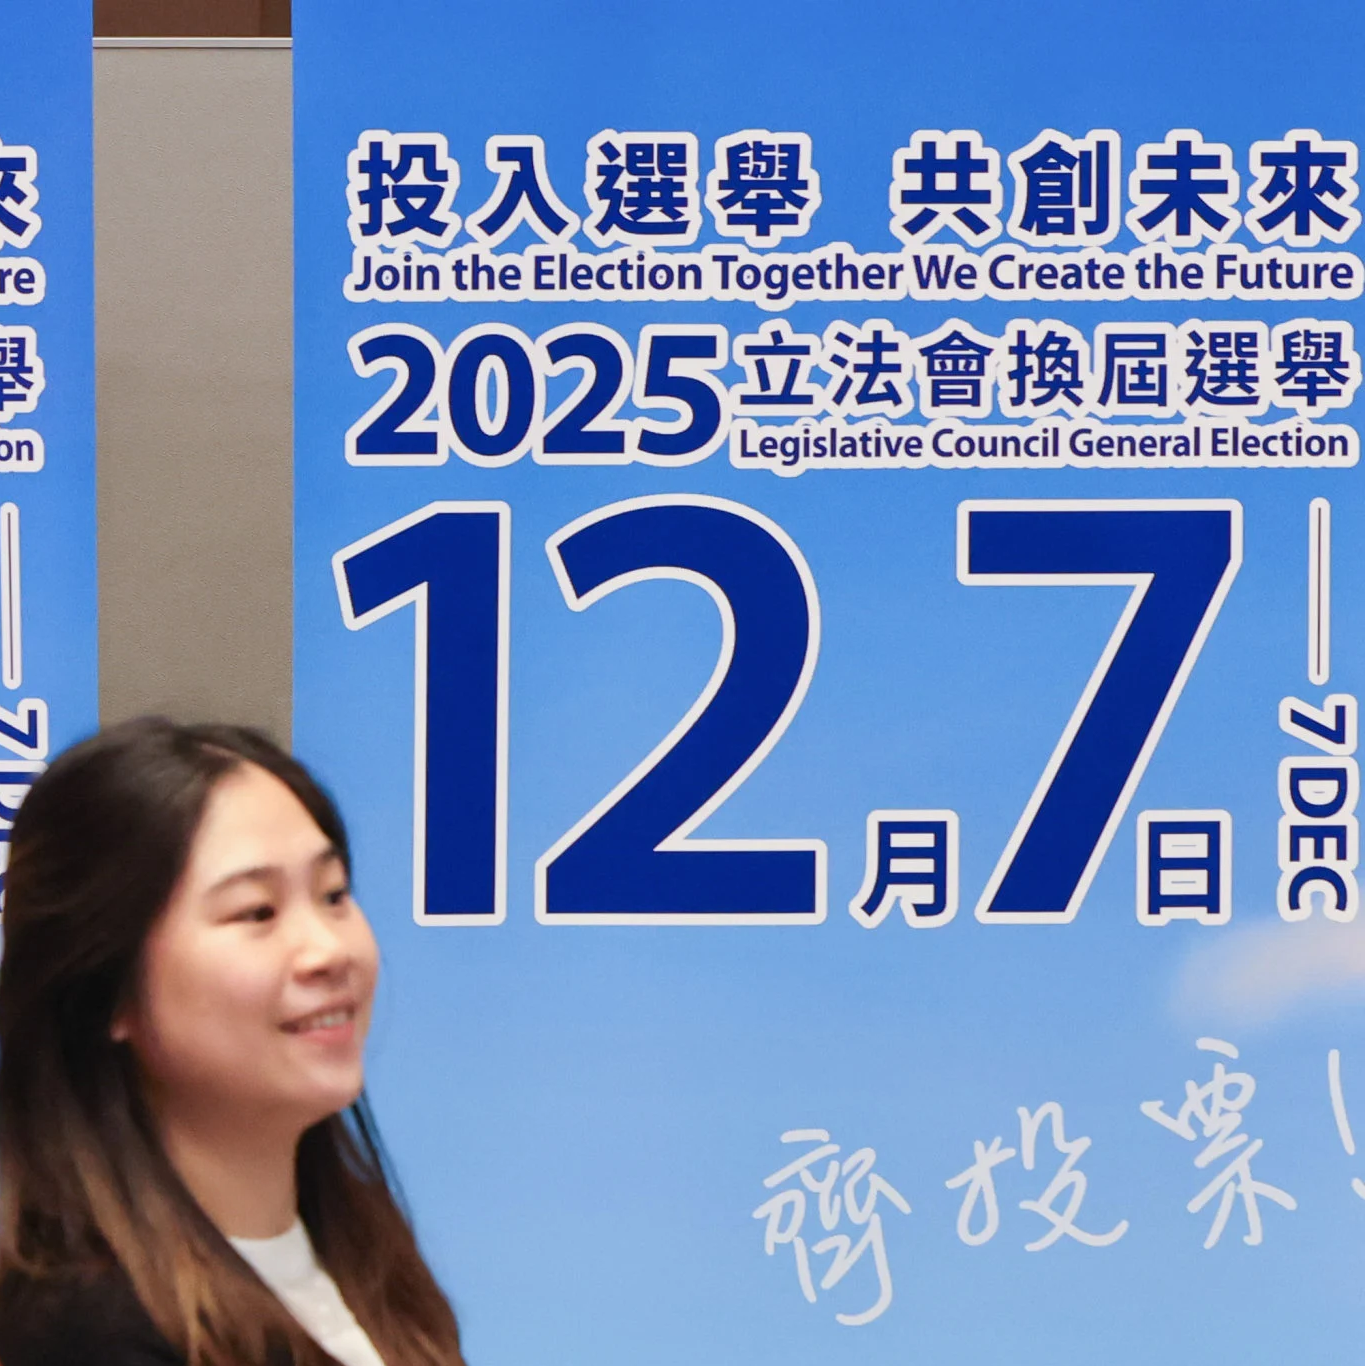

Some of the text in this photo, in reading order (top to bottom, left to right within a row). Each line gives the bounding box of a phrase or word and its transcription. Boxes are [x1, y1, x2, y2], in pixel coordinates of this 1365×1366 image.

[357, 140, 1349, 237] 投入選舉 共創未來
[354, 253, 1353, 300] Join the Election Together We Create the Future
[356, 329, 1349, 457] 2025 立法會換屆選舉
[741, 426, 1348, 466] Legislative Council General Election
